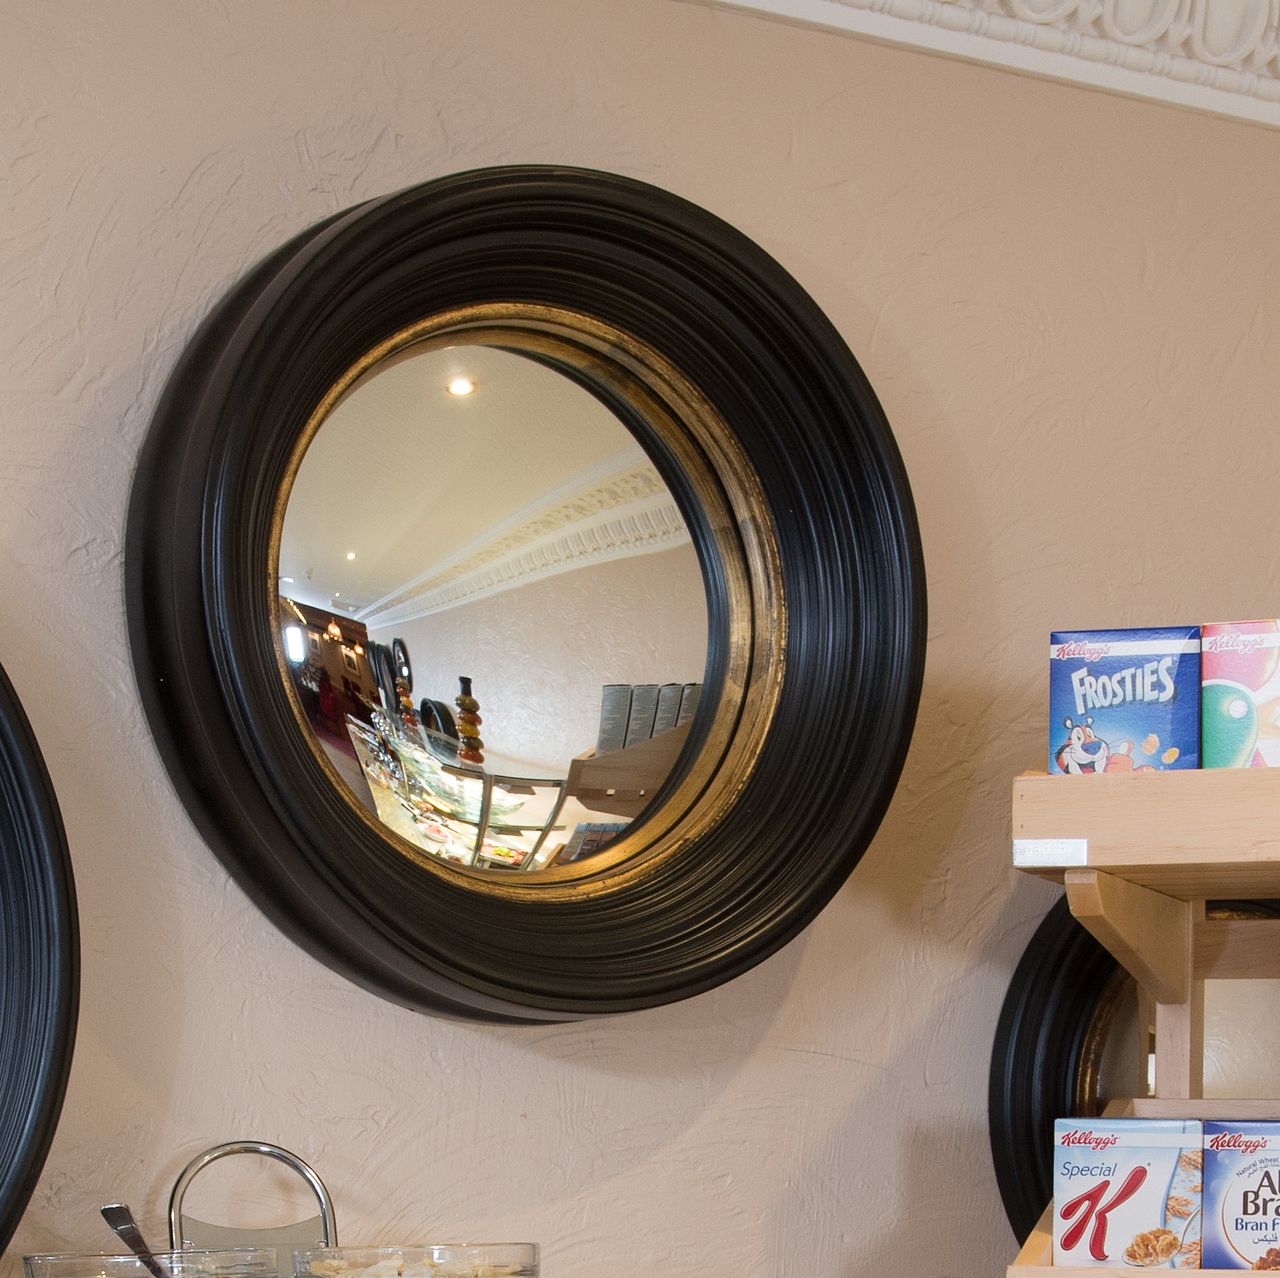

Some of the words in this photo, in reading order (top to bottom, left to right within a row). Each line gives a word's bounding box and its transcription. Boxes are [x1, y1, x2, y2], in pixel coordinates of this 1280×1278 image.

[1056, 642, 1110, 661] Kellogg's
[1209, 633, 1265, 653] Kellogg's
[1071, 656, 1175, 715] FROSTIES
[1060, 1130, 1118, 1150] Kellogg's
[1209, 1132, 1268, 1154] Kellogg's
[1060, 1161, 1118, 1180] Special
[1236, 1160, 1258, 1178] Natural
[1258, 1157, 1280, 1166] Wheat
[1059, 1165, 1148, 1261] K
[1234, 1217, 1268, 1232] Bran
